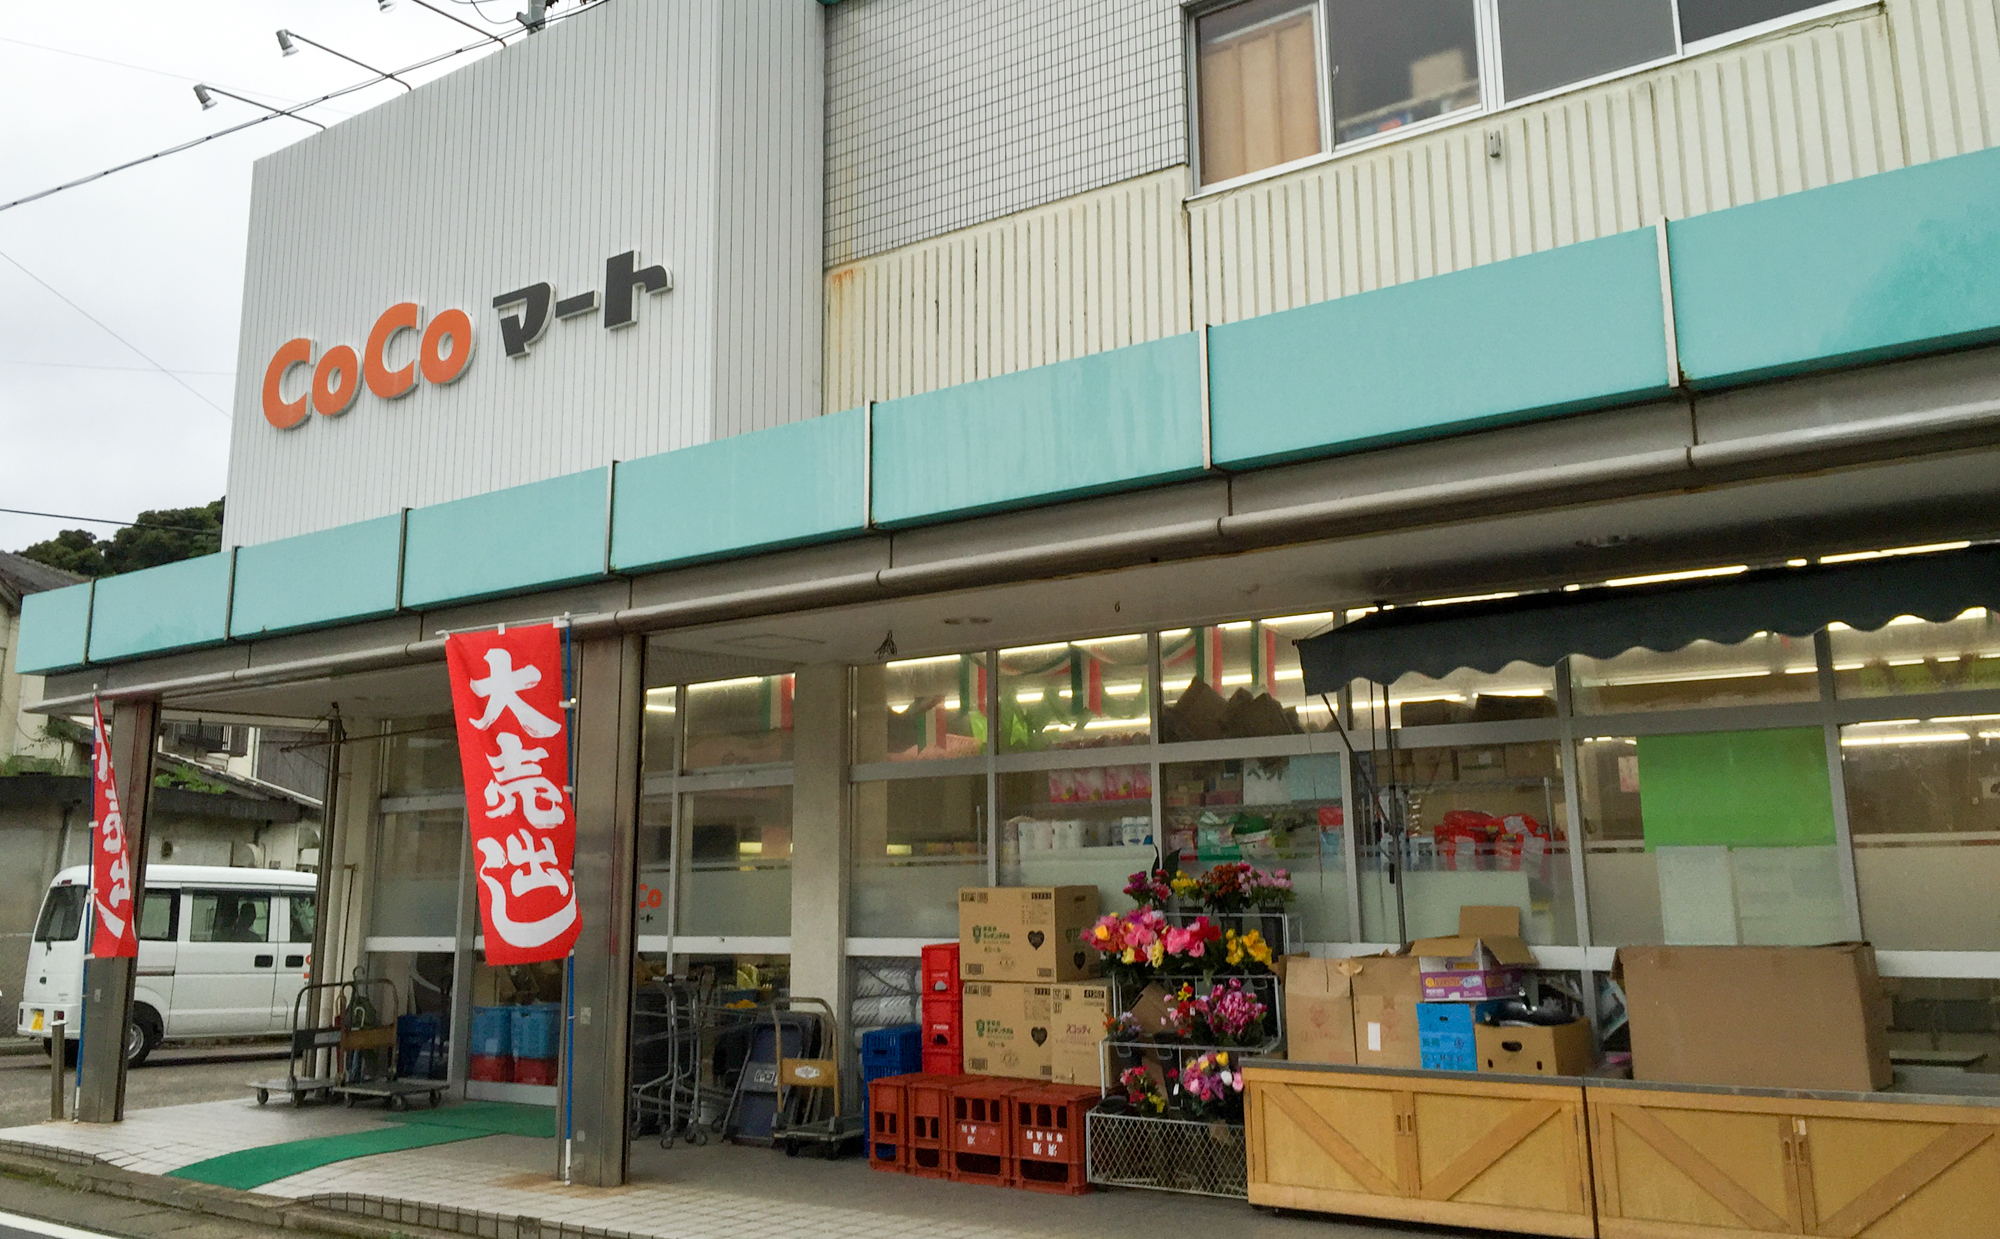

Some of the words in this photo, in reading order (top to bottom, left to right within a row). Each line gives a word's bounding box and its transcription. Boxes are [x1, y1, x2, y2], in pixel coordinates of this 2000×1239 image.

[263, 302, 475, 429] CoCo
[493, 250, 672, 357] マート
[468, 647, 577, 948] 大売出し
